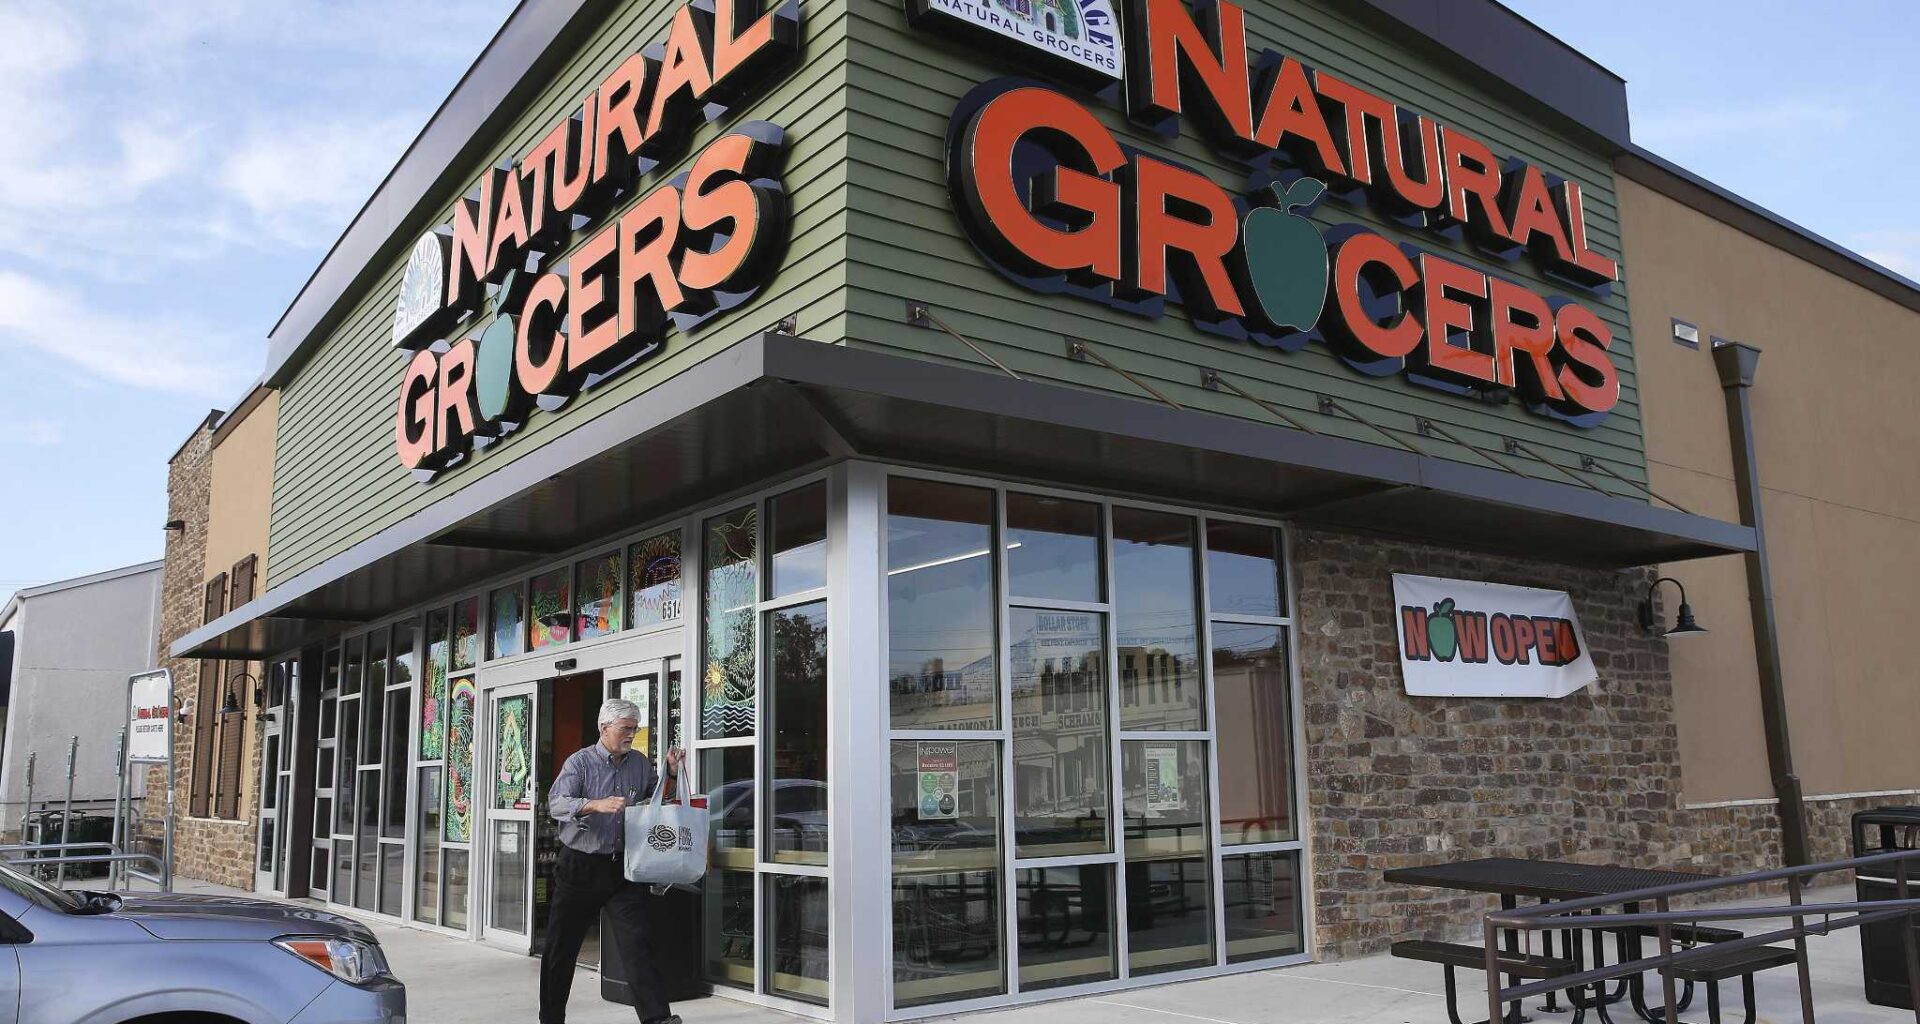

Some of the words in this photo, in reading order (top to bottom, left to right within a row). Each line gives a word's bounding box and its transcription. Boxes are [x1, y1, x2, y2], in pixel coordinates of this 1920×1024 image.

[937, 0, 1025, 36] NATURAL
[1033, 30, 1116, 70] GROCERS
[448, 0, 773, 307] NATURAL
[1146, 0, 1618, 282] NATURAL
[1489, 611, 1581, 667] OPEN
